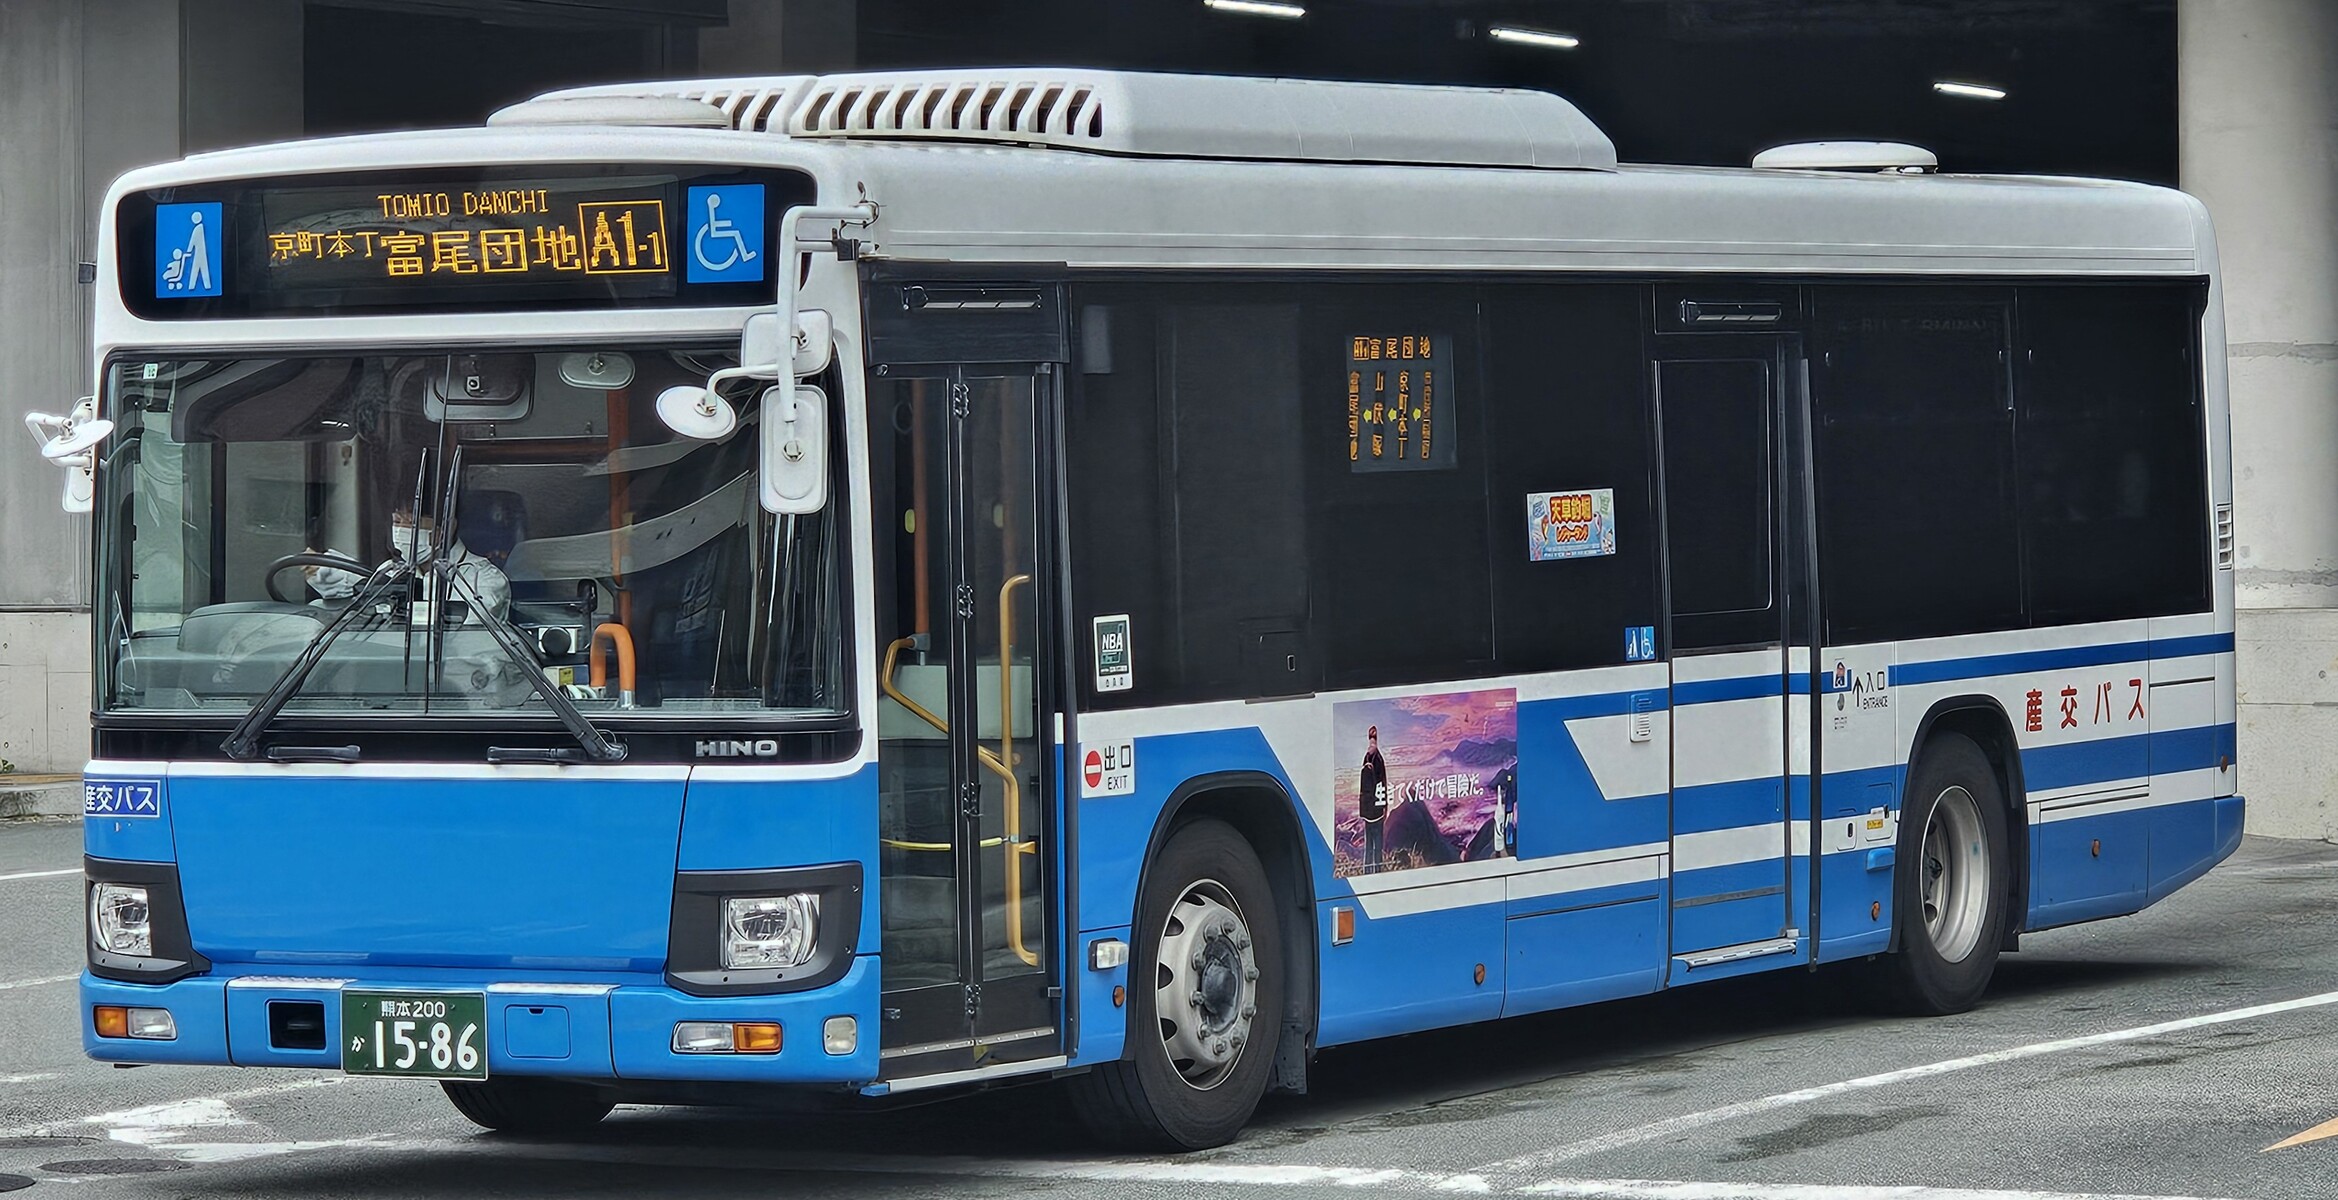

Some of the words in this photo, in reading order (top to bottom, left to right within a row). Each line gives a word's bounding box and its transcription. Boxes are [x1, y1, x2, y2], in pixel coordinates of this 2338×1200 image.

[378, 192, 450, 218] TOMIO
[464, 189, 549, 217] DANCHI
[268, 230, 379, 260] 京町本丁
[380, 226, 582, 276] 富尾団地
[1101, 632, 1124, 650] NBA
[1865, 671, 1885, 693] 入口
[2025, 677, 2145, 733] 産交バス
[695, 740, 778, 757] HINO
[1104, 745, 1132, 771] 出口
[1107, 775, 1128, 790] EXIT
[375, 1020, 479, 1071] 15-86
